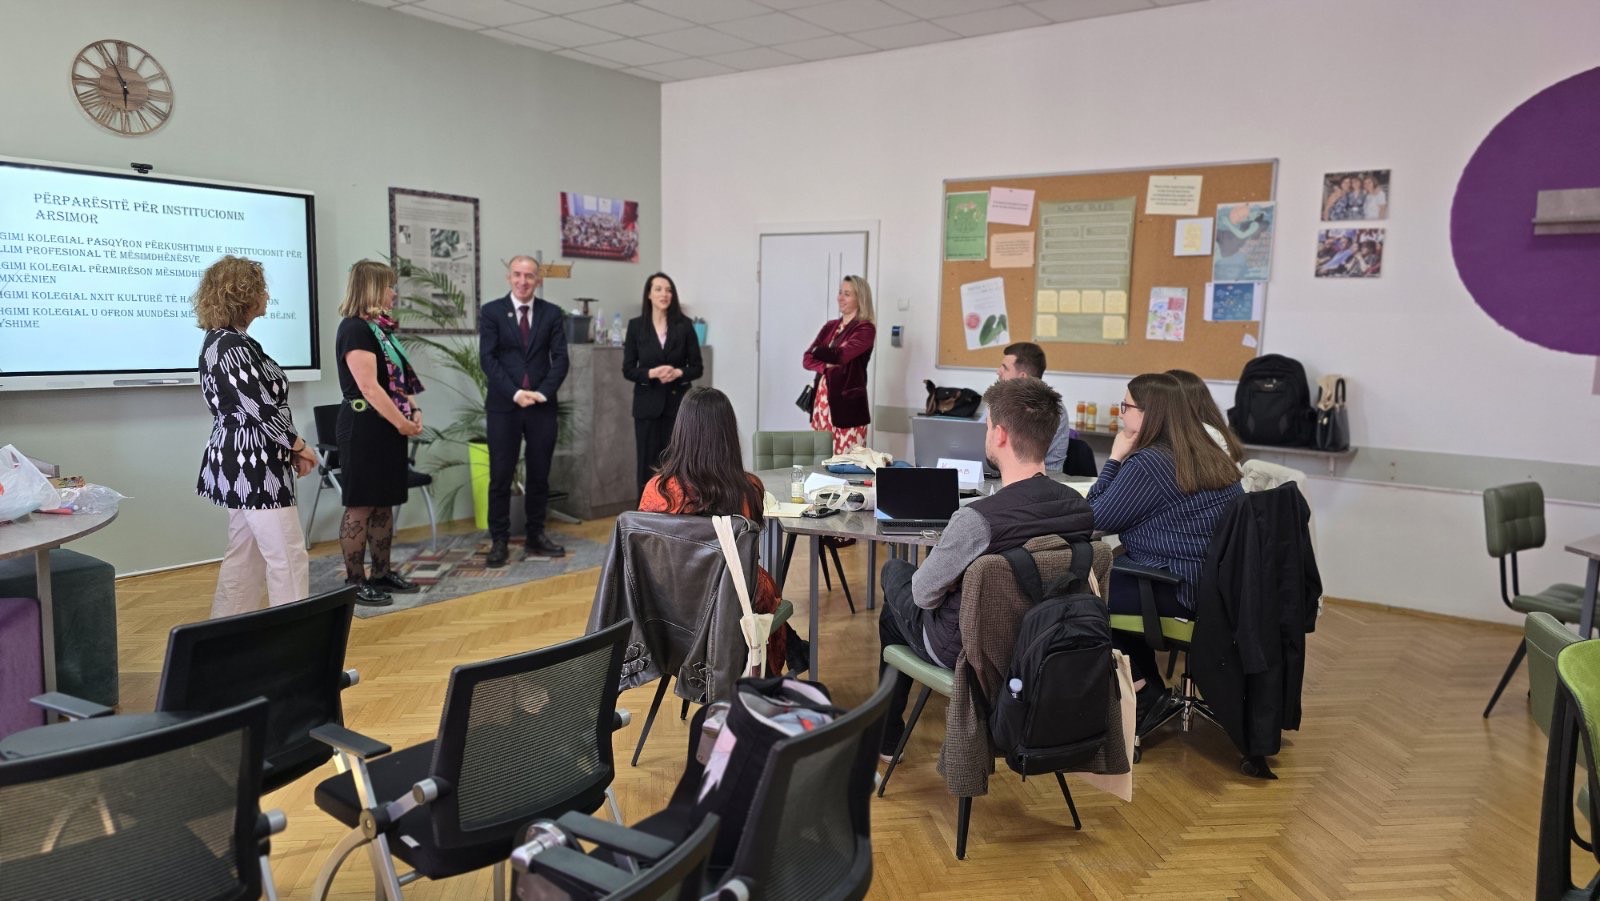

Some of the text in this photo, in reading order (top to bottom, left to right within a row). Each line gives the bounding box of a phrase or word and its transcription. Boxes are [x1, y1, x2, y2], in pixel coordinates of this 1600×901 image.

[34, 192, 245, 221] PËRPARËSITË PËR INSTITUCIONIN
[36, 209, 99, 224] ARSIMOR
[27, 233, 84, 245] KOLEGIAL
[87, 237, 142, 248] PASQYRON
[145, 240, 214, 253] PËRKUSHTIMIN
[225, 246, 284, 257] INSTITUCIONIT
[26, 246, 101, 258] PROFESIONAL
[103, 249, 117, 259] TË
[30, 262, 86, 273] KOLEGIAL
[89, 264, 153, 276] PËRMIRËSON
[31, 291, 88, 301] KOLEGIAL
[90, 293, 114, 301] NXIT
[117, 293, 162, 303] KULTURË
[33, 307, 88, 316] KOLEGIAL
[91, 308, 98, 316] U
[100, 309, 134, 317] OFRON
[137, 309, 178, 318] MUNDËSI
